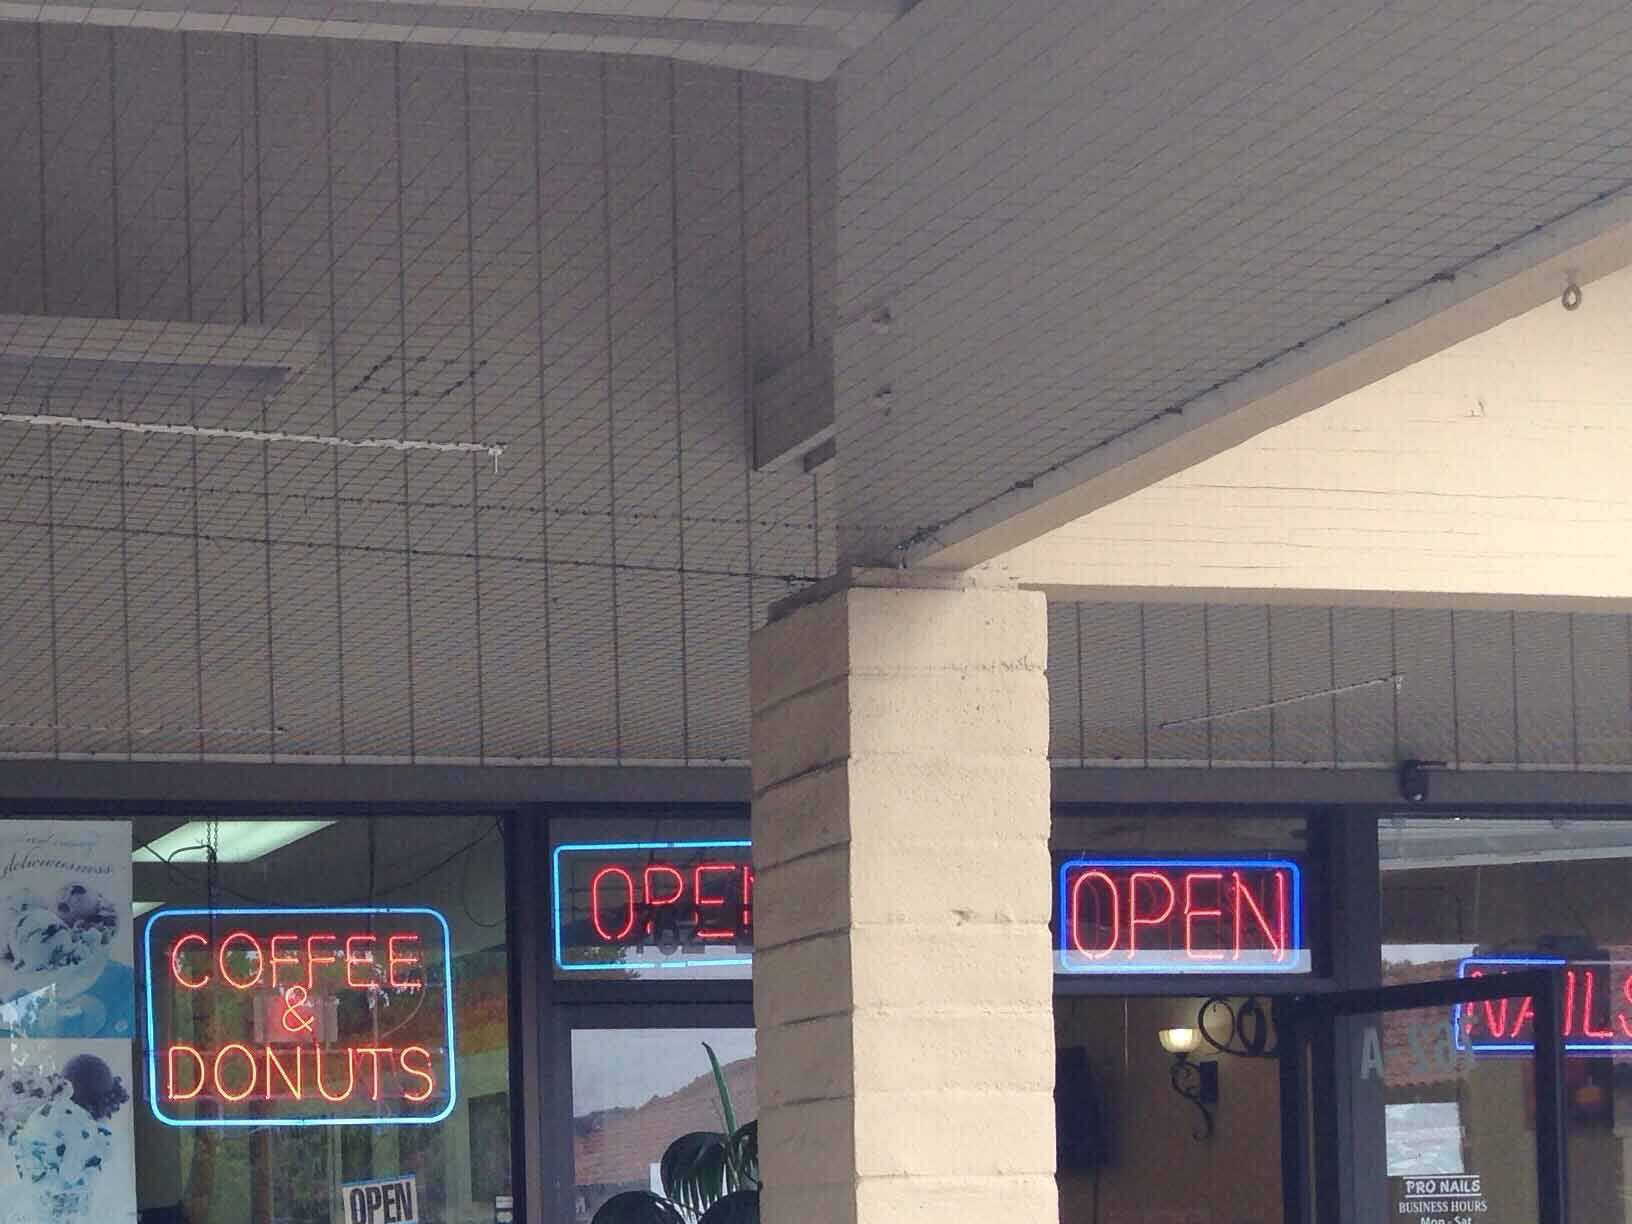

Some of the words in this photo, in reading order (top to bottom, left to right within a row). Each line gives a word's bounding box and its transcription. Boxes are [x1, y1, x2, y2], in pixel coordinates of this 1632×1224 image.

[1071, 870, 1285, 962] OPEN
[170, 931, 423, 990] COFFEE
[282, 984, 315, 1033] &
[167, 1043, 434, 1101] DONUTS
[1399, 1202, 1448, 1213] BUSINESS
[1451, 1200, 1488, 1212] HOURS
[1406, 1180, 1436, 1194] PRO
[1440, 1179, 1481, 1193] NAILS
